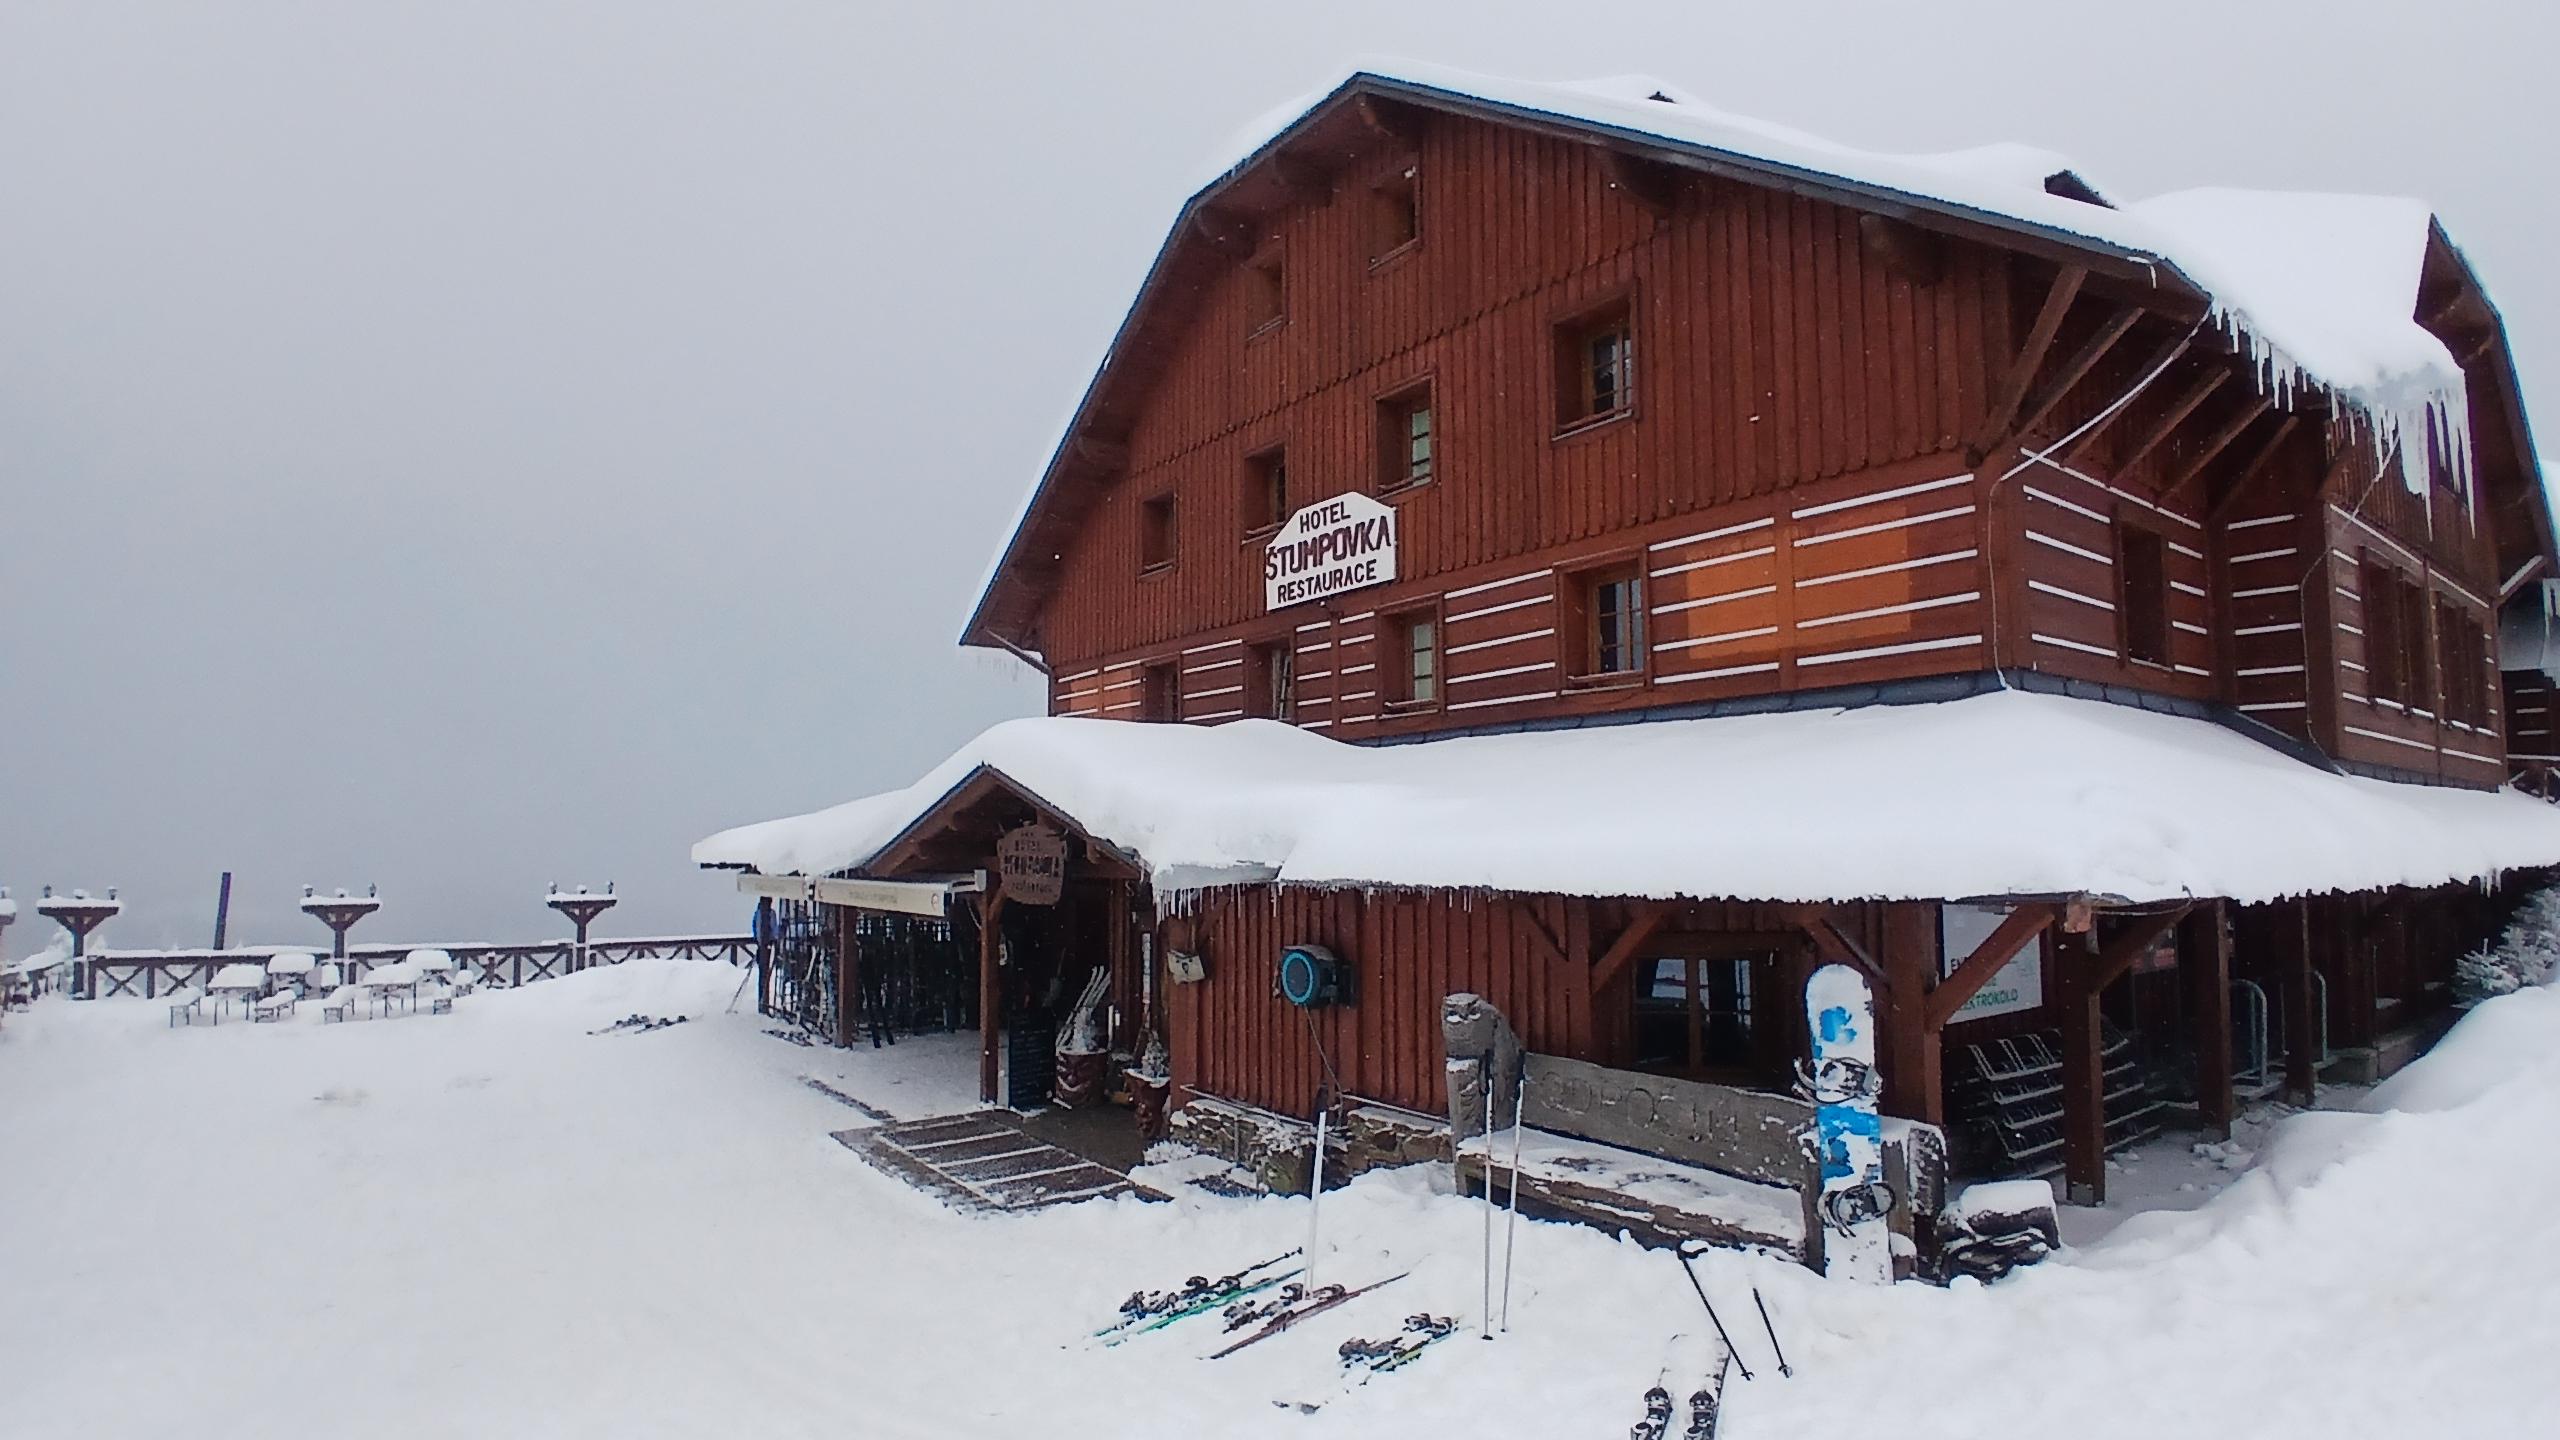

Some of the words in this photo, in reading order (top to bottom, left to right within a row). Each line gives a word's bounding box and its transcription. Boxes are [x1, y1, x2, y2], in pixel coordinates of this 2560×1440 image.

[1300, 501, 1351, 533] HOTEL
[1265, 515, 1391, 580] ŠTUMPOVKA
[1277, 559, 1377, 603] RESTAURACE
